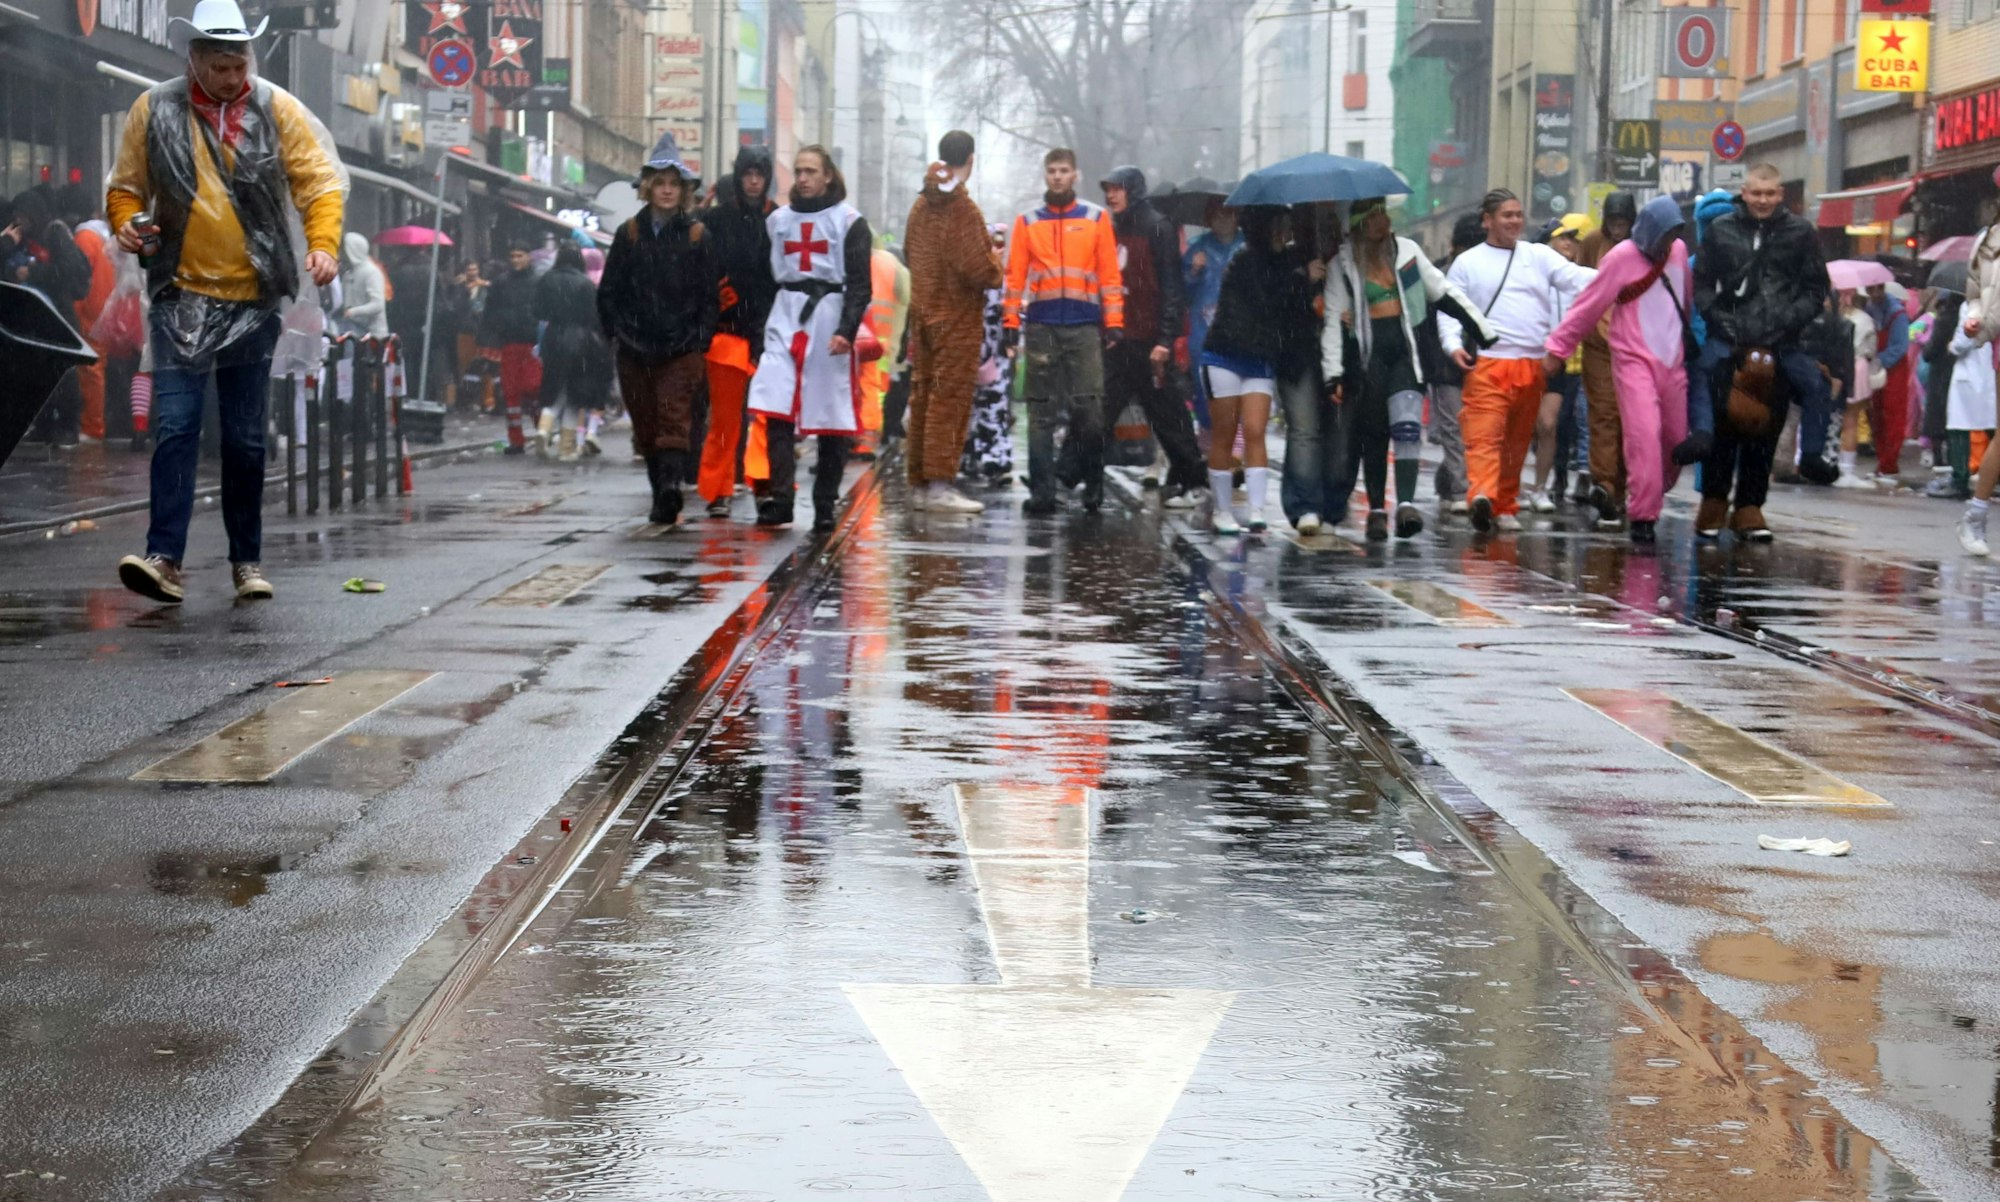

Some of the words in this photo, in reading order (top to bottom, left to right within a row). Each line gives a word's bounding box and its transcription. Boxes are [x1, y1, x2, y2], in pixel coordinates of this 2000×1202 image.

[1864, 58, 1919, 72] CUBA
[481, 70, 531, 87] BAR
[1870, 75, 1912, 88] BAR
[1935, 96, 1973, 150] CUBA
[1977, 86, 2000, 141] BA
